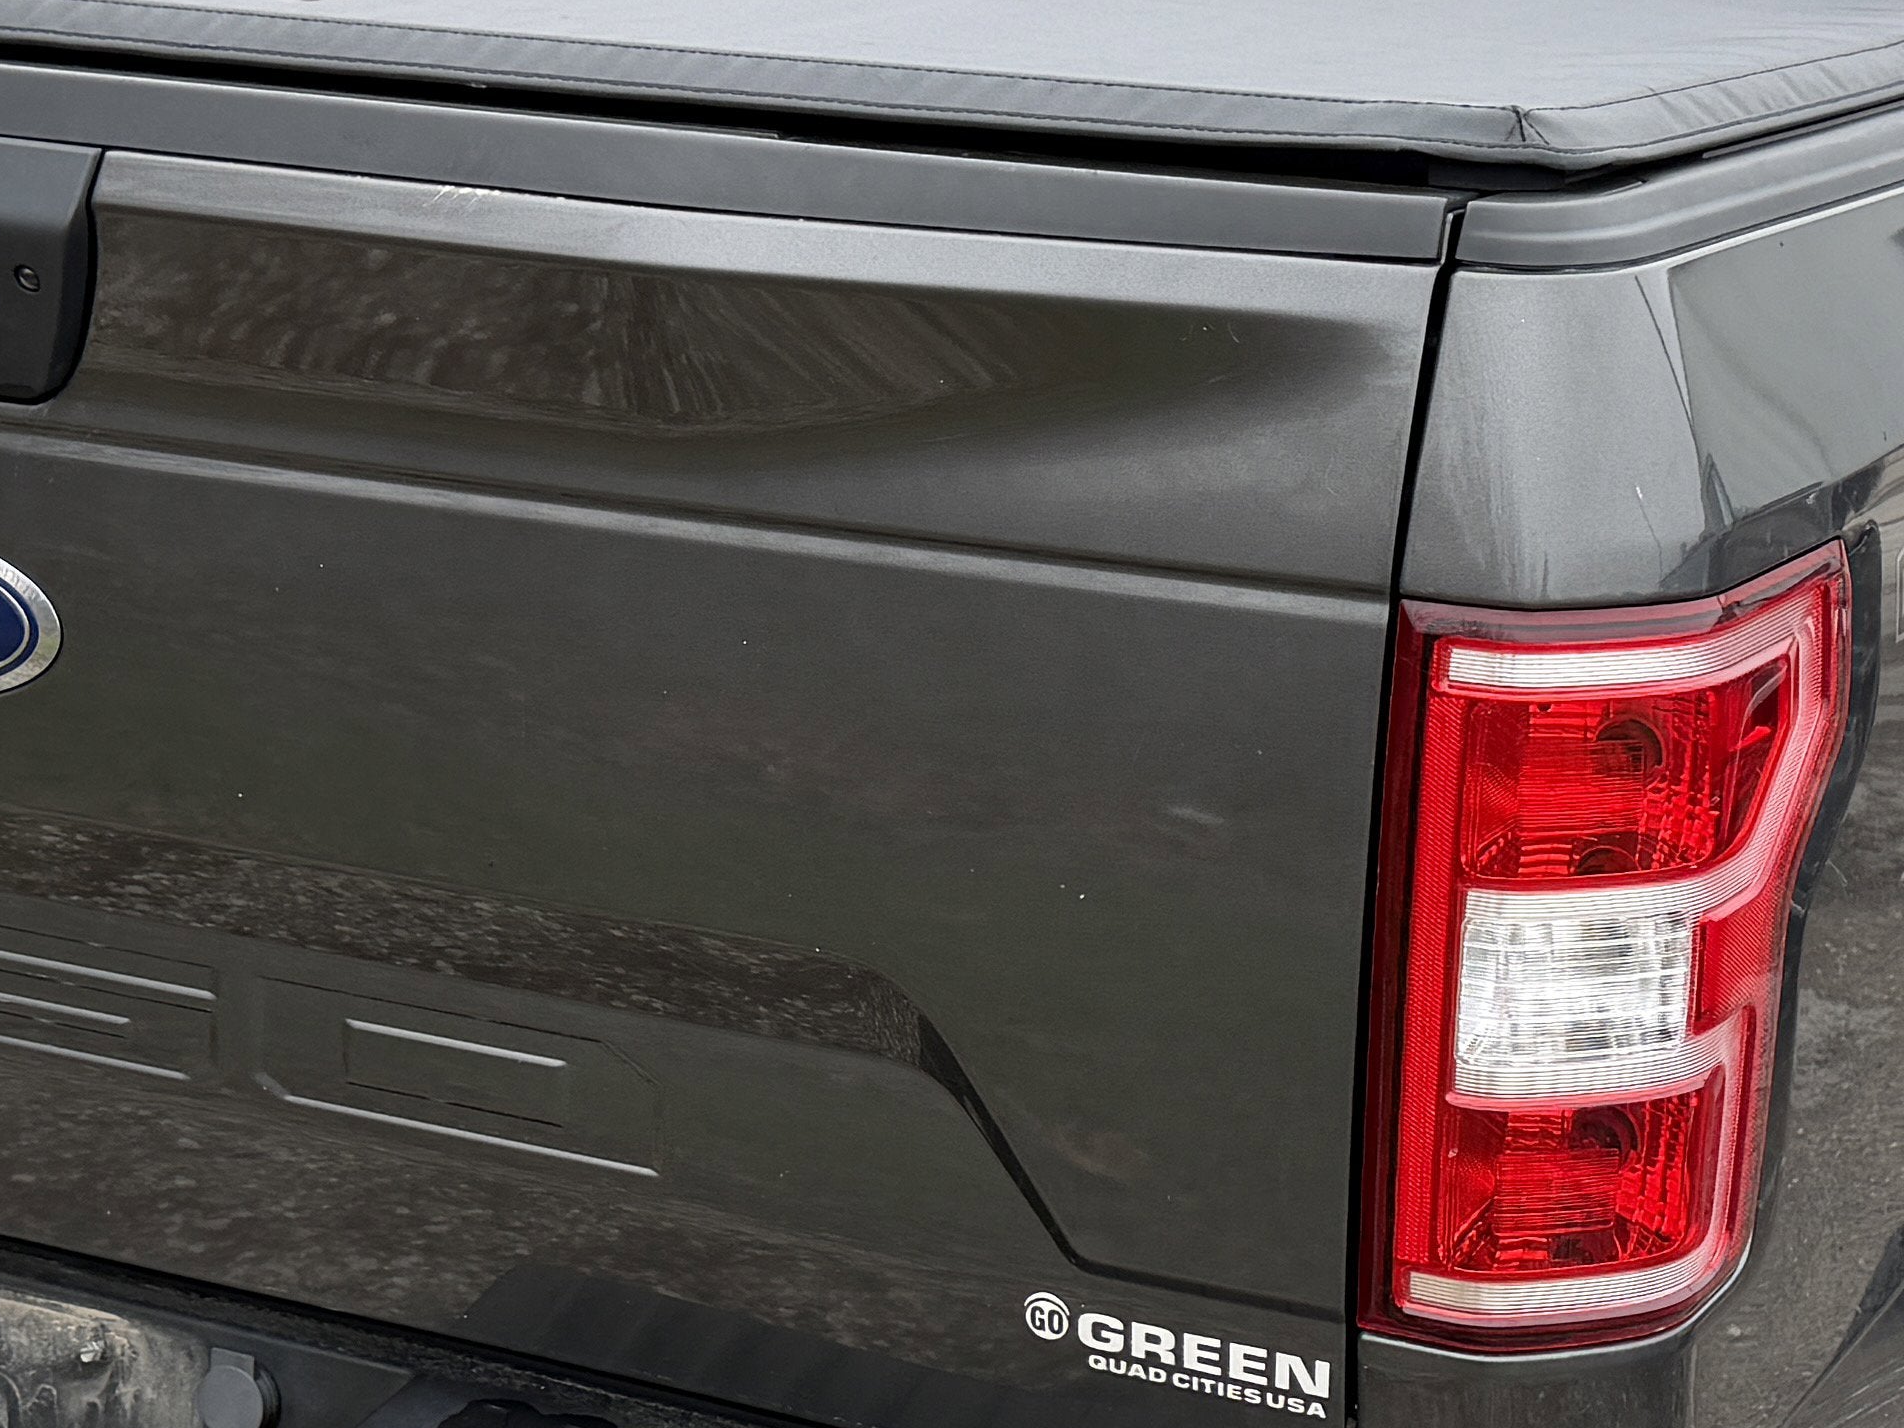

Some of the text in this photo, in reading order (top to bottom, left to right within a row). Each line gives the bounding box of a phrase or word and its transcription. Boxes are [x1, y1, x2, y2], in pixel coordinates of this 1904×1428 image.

[1029, 1304, 1331, 1399] GO GREEN
[1087, 1354, 1327, 1419] QUAD CITIES USA
